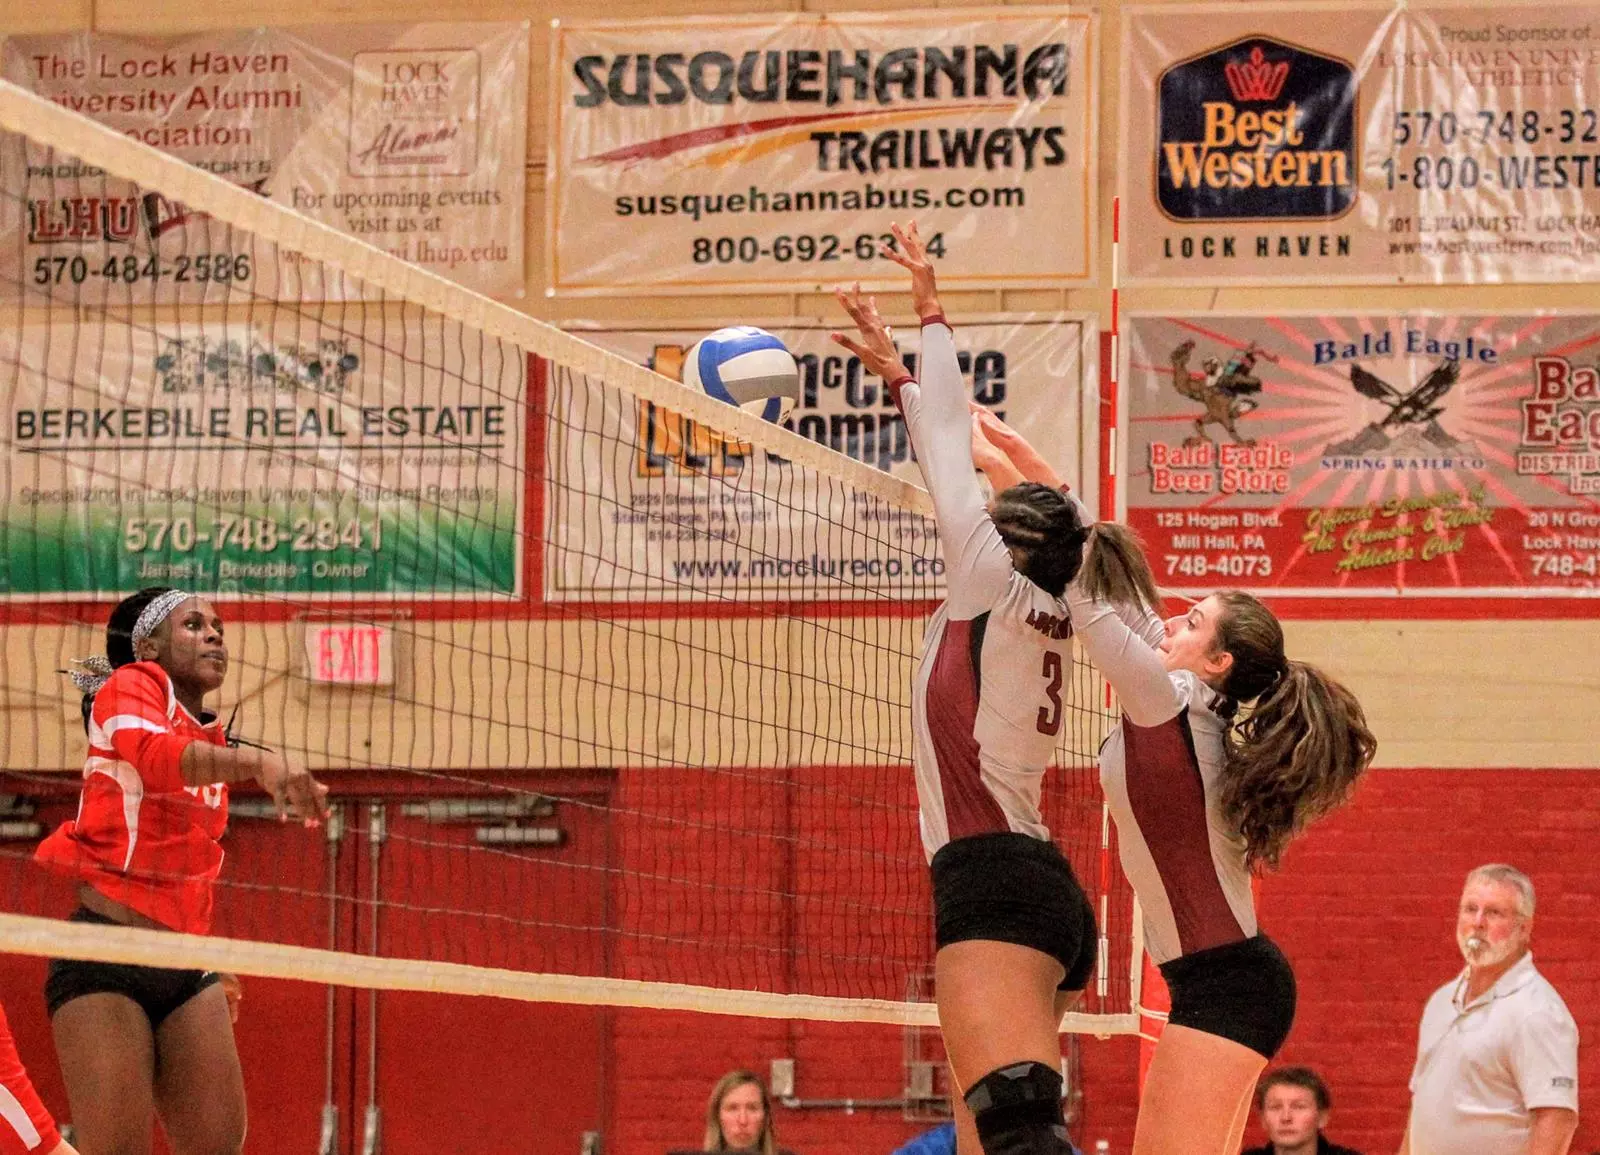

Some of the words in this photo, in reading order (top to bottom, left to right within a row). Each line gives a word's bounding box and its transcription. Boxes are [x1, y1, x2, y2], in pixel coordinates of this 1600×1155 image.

[1440, 25, 1491, 42] Proud
[1496, 25, 1568, 45] Sponsor
[33, 55, 86, 79] The
[100, 54, 177, 79] Lock
[190, 52, 289, 75] Haven
[381, 62, 448, 83] LOCK
[573, 43, 1069, 107] SUSQUEHANNA
[50, 89, 176, 117] iversity
[186, 84, 301, 110] Alumni
[125, 121, 251, 147] ociation
[1203, 101, 1304, 148] Best
[810, 126, 1066, 174] TRAILWAYS
[1162, 140, 1350, 189] Western
[292, 186, 325, 209] For
[332, 185, 434, 214] upcoming
[437, 187, 503, 207] events
[615, 184, 1026, 220] susquehannabus.com
[31, 198, 137, 241] LHU
[348, 212, 389, 234] visit
[396, 217, 418, 233] us
[424, 214, 443, 233] at
[692, 232, 948, 264] 800-692-634
[1164, 237, 1237, 258] LOCK
[1256, 235, 1350, 258] HAVEN
[35, 254, 250, 284] 570-484-2586
[1314, 332, 1391, 365] Bald
[1407, 330, 1498, 364] Eagle
[16, 408, 231, 440] BERKEBILE
[245, 407, 347, 437] REAL
[363, 405, 506, 437] ESTATE
[1151, 442, 1212, 468] Bald
[1219, 442, 1294, 470] Eagle
[1321, 459, 1386, 470] SPRING
[1394, 459, 1453, 470] WATER
[1153, 468, 1214, 492] Beer
[1221, 467, 1291, 492] Store
[1156, 512, 1184, 527] 125
[1187, 512, 1239, 530] Hogan
[1552, 512, 1565, 528] N
[1172, 534, 1201, 549] Mill
[1243, 534, 1265, 549] PA
[1523, 533, 1561, 549] Lock
[673, 554, 946, 580] www.mcclureco.co
[1163, 554, 1272, 577] 748-4073
[1531, 554, 1600, 577] 748-4
[319, 627, 384, 680] EXIT
[1036, 650, 1063, 737] 3
